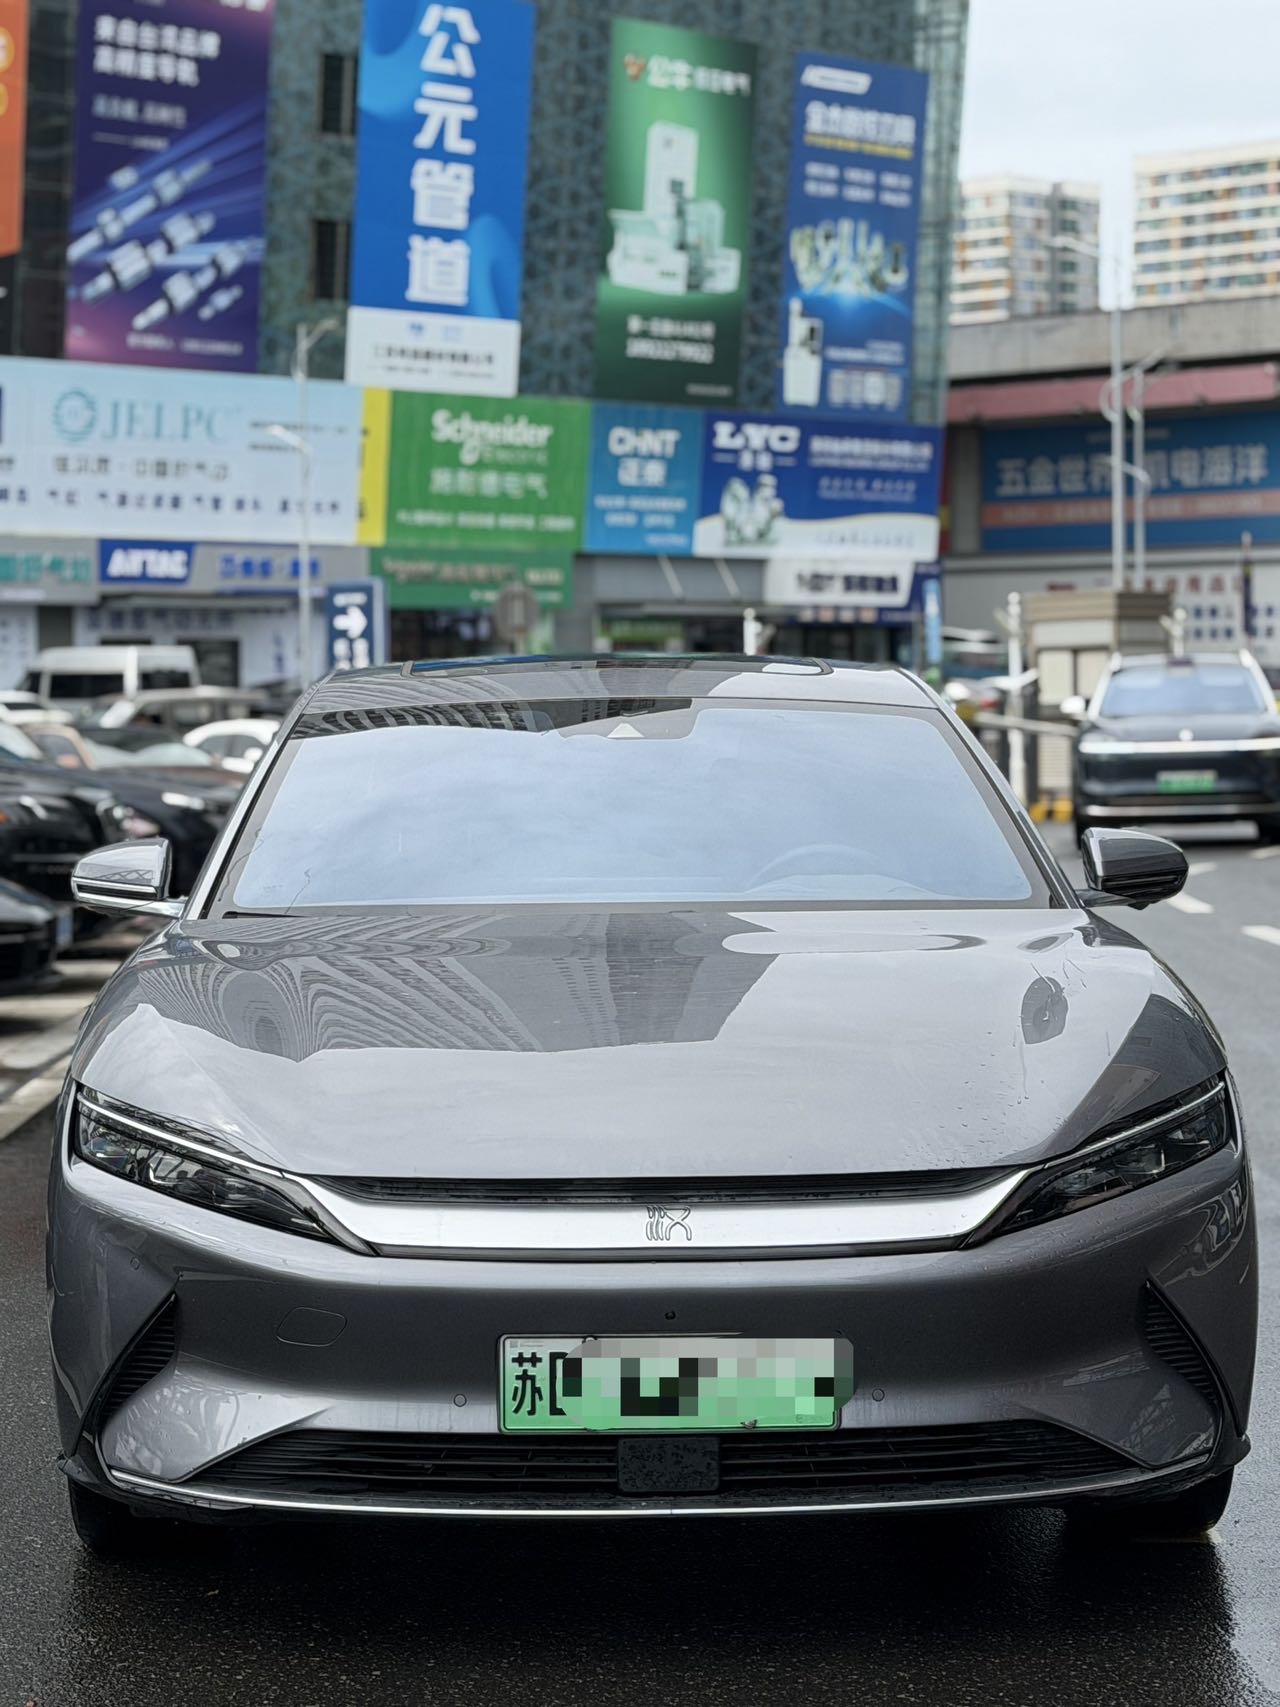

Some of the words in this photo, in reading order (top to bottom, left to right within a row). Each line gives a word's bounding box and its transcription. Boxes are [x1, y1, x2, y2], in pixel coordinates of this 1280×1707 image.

[404, 3, 481, 306] 公元管道
[431, 409, 553, 466] Schneider
[713, 420, 801, 452] LYC
